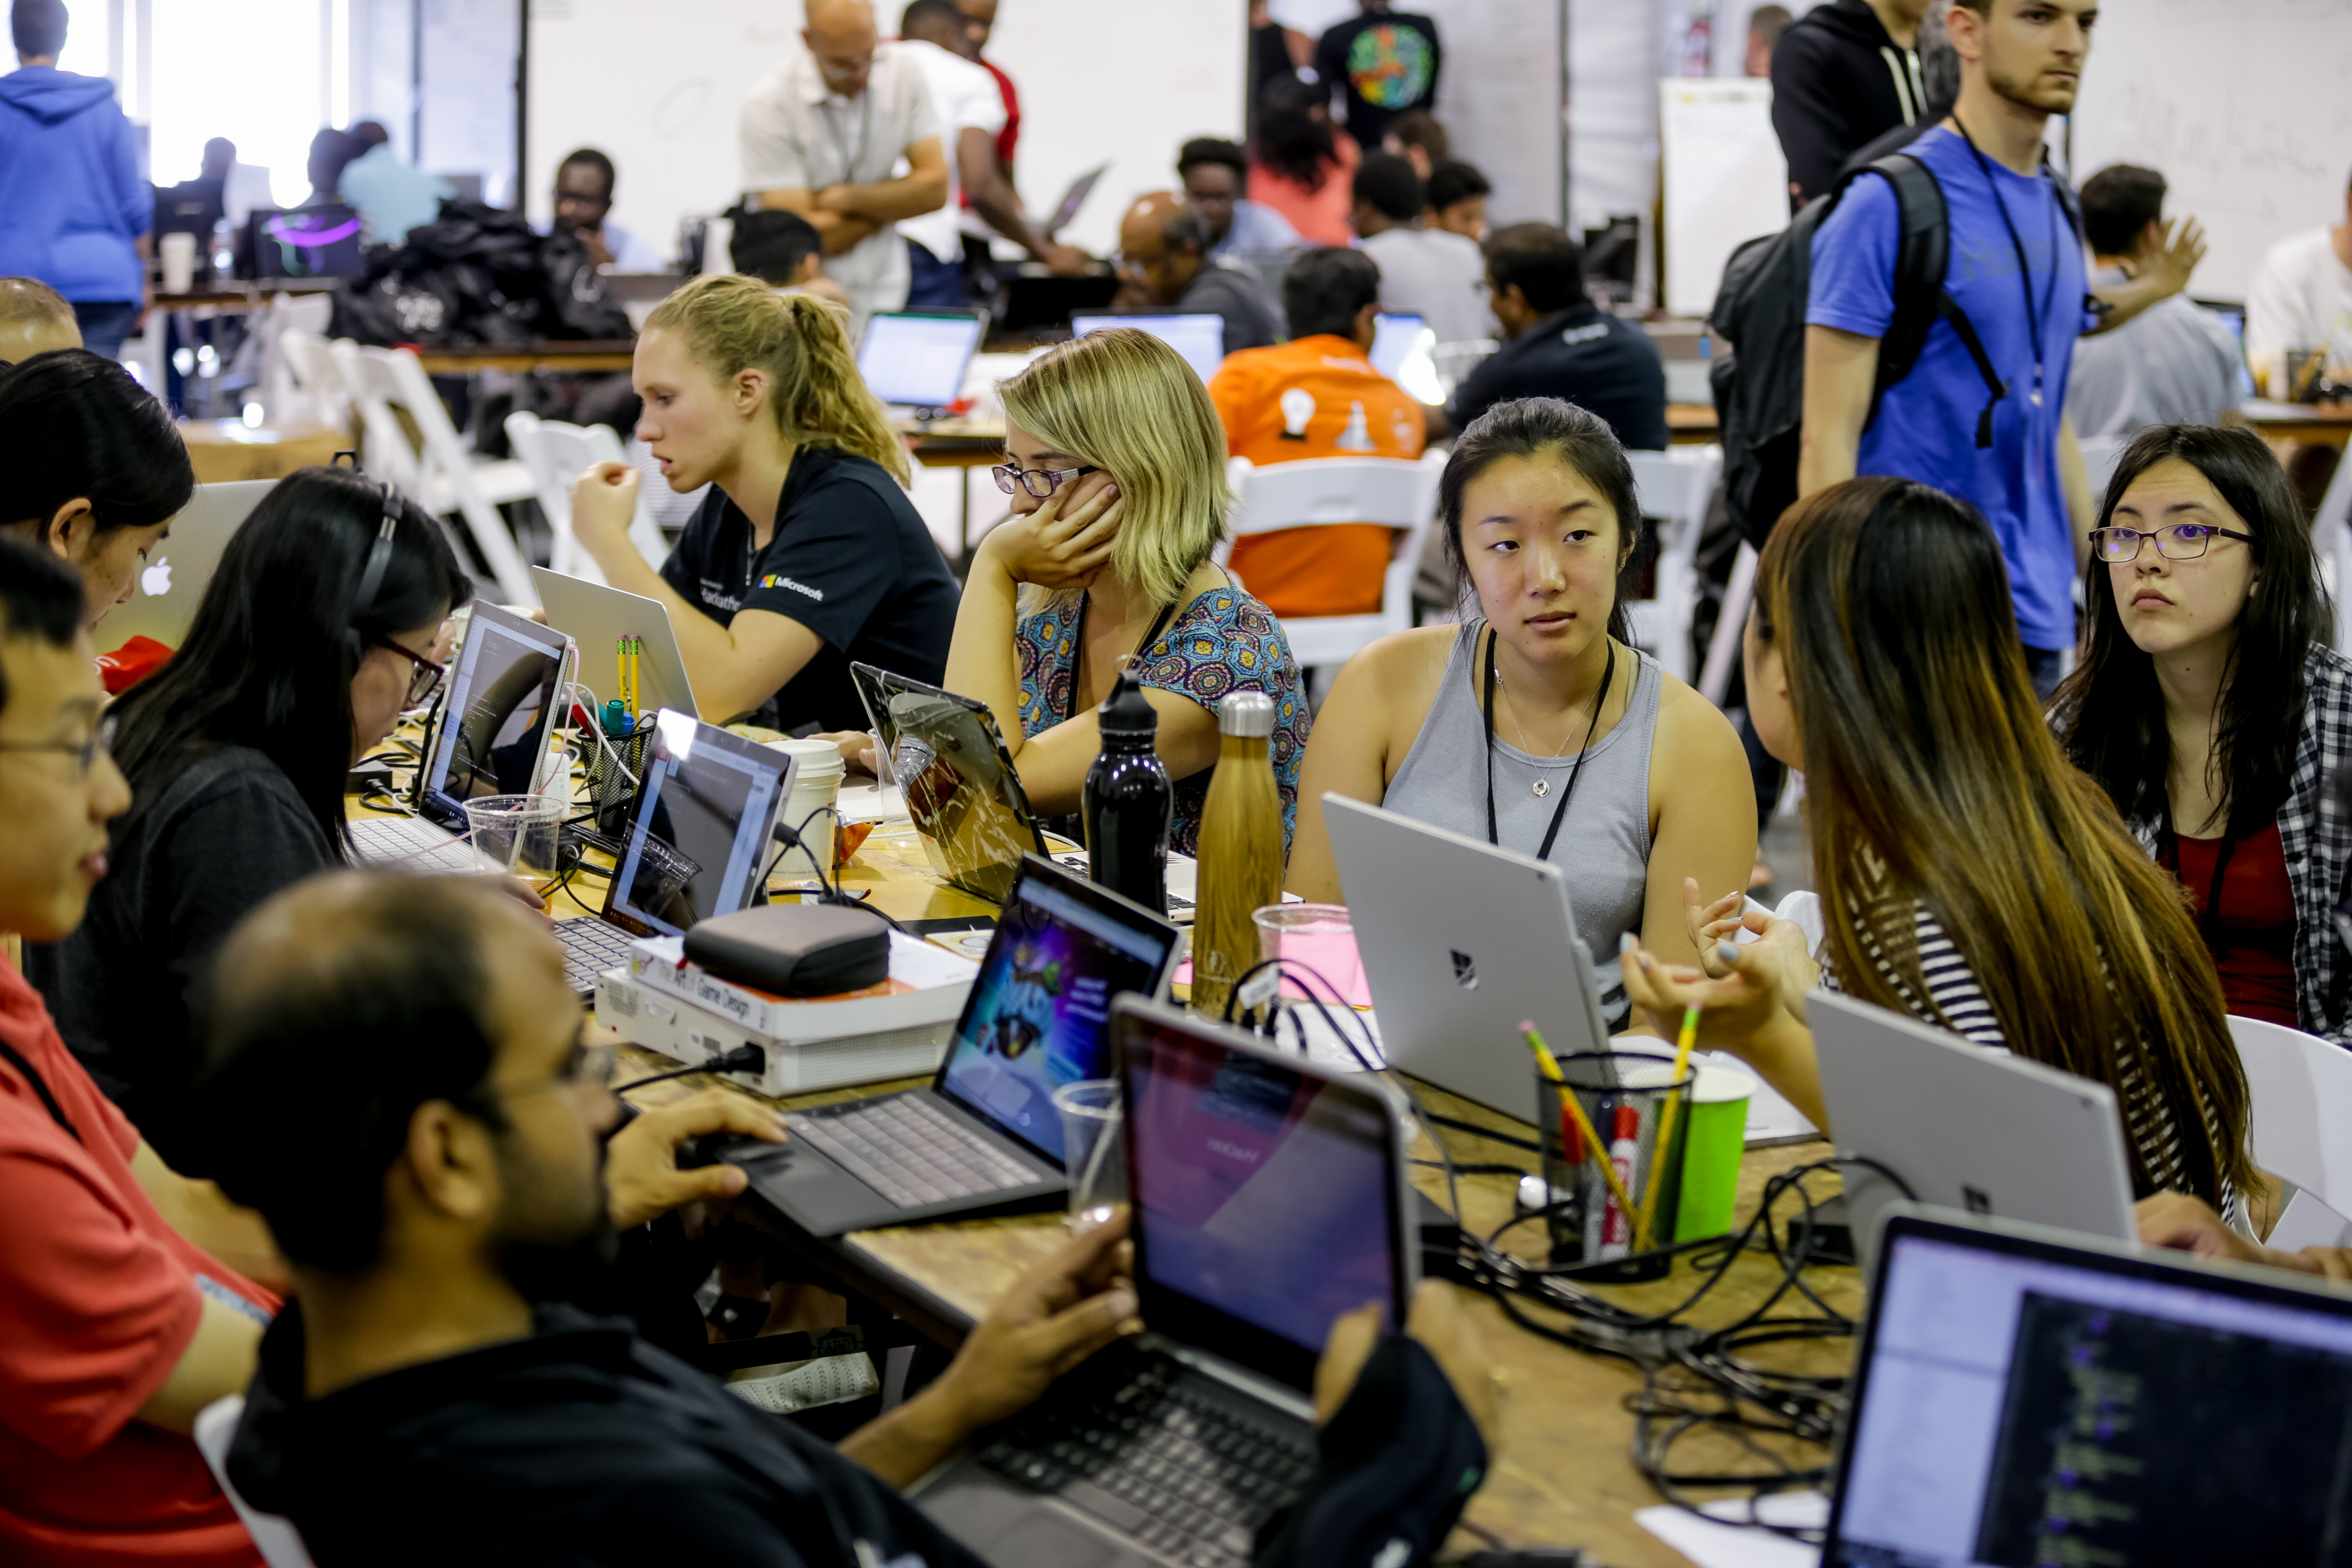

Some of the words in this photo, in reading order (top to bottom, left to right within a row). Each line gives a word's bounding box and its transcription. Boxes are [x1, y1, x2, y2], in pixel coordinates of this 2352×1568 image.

[774, 576, 823, 601] Microsoft
[697, 977, 720, 1005] Game
[722, 988, 749, 1020] Design
